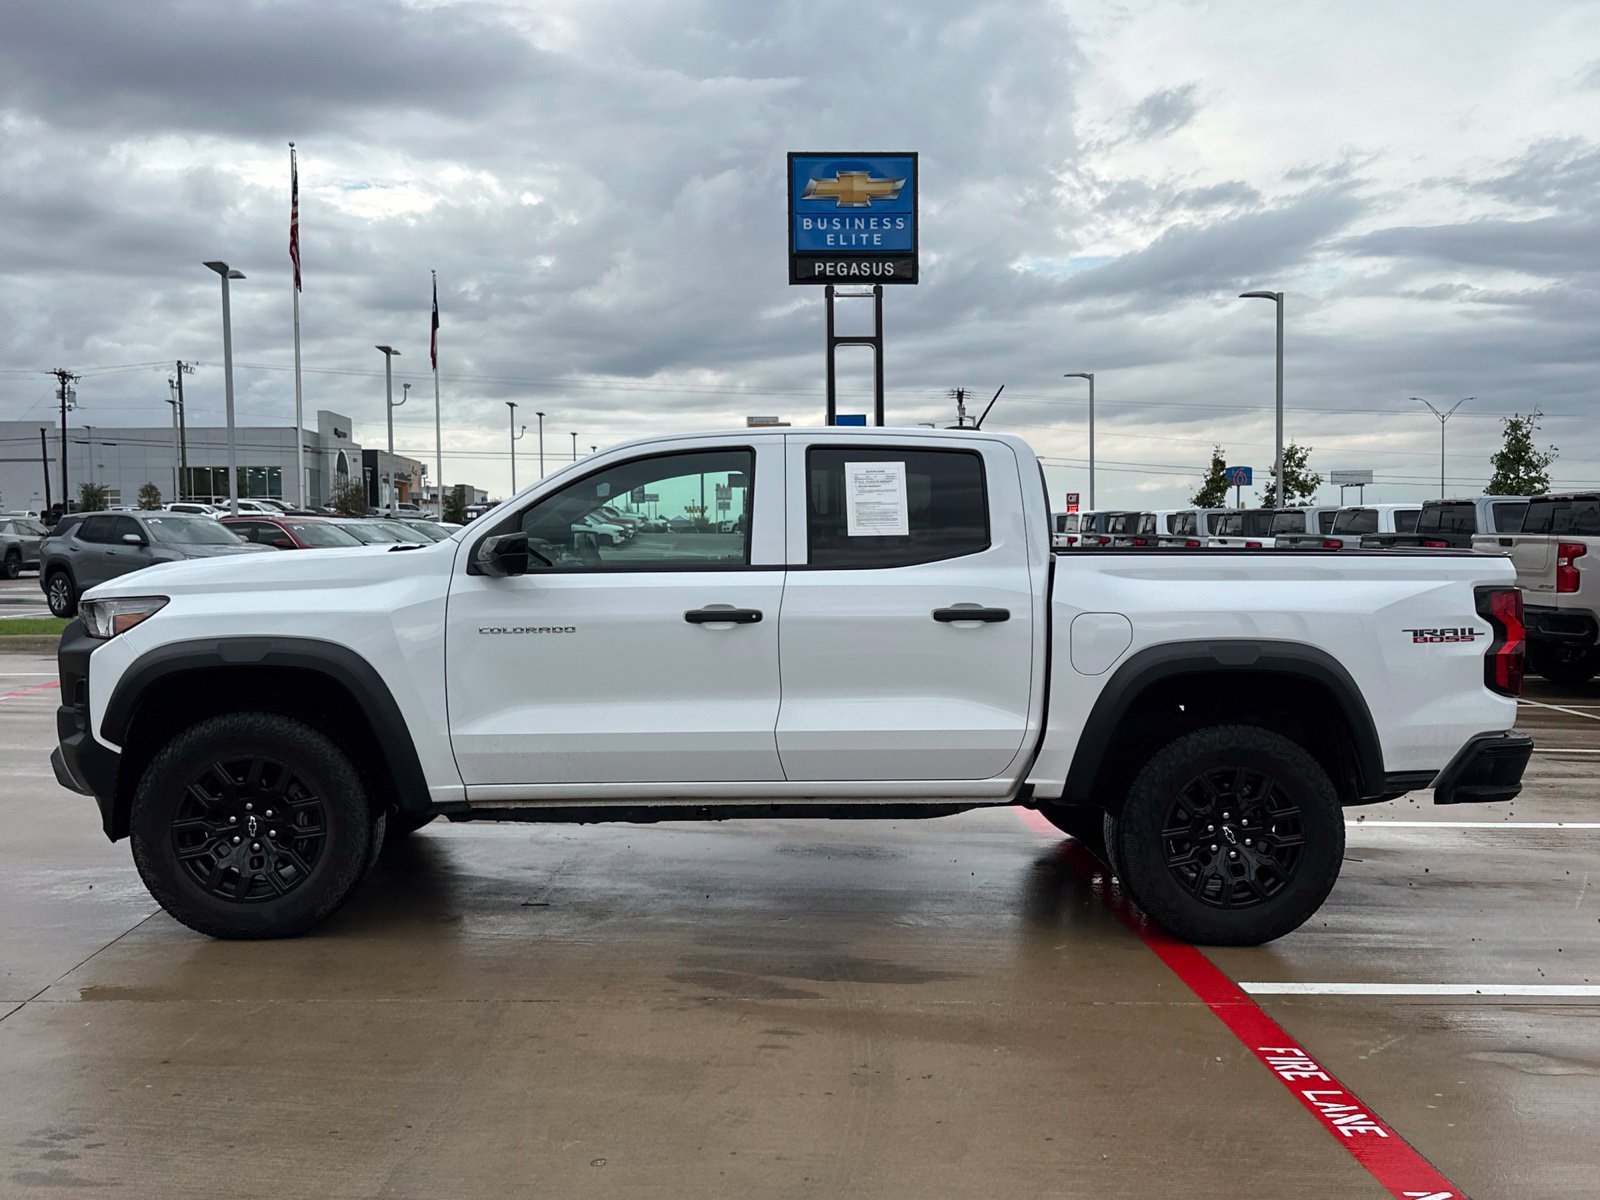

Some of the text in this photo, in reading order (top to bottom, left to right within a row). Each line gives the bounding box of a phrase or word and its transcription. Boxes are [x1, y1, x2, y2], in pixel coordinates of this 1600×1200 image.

[803, 218, 905, 230] BUSINESS
[826, 233, 882, 246] ELITE
[814, 262, 895, 276] PEGASUS
[1233, 467, 1248, 486] 6
[479, 626, 576, 635] COLORADO
[1402, 627, 1485, 637] TRAIL
[1412, 635, 1475, 644] BOSS
[1258, 1047, 1389, 1138] FIRE LANE
